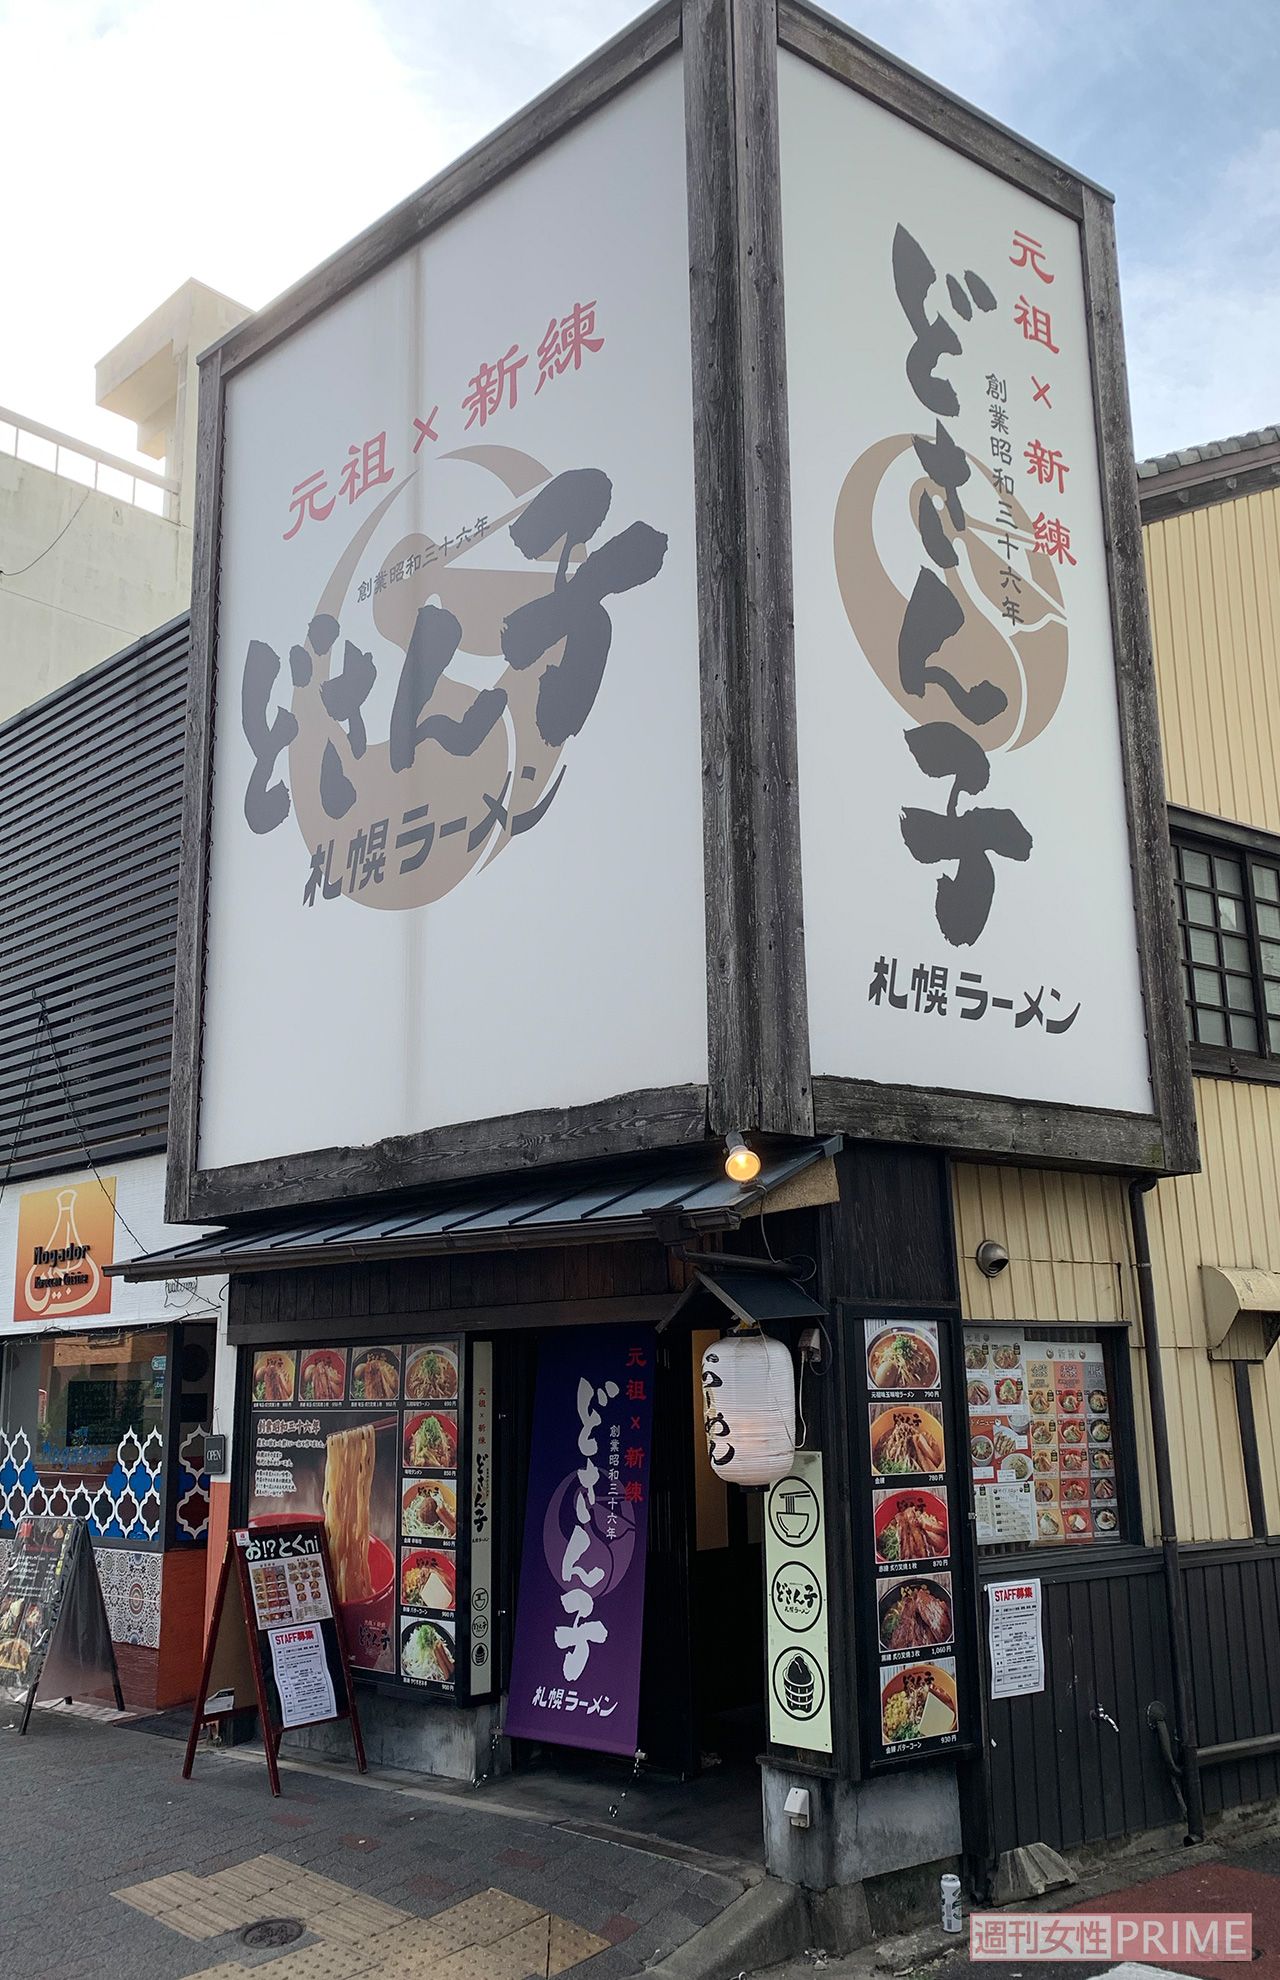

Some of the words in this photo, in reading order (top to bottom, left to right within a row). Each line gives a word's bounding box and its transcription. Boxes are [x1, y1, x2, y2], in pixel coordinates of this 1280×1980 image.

[984, 373, 1025, 628] 創業昭和三十六年
[356, 515, 491, 604] 創業昭和三十六年
[892, 223, 1033, 947] どさん子
[242, 468, 669, 834] どさん子
[302, 764, 566, 907] 札幌ラーメン
[868, 956, 1081, 1035] 札幌ラーメン
[206, 1450, 221, 1461] OPEN
[605, 1424, 621, 1540] 創業昭和三十六年
[554, 1377, 620, 1682] どさん子
[776, 1581, 818, 1608] どさん子
[531, 1685, 619, 1718] 札幌ラーメン
